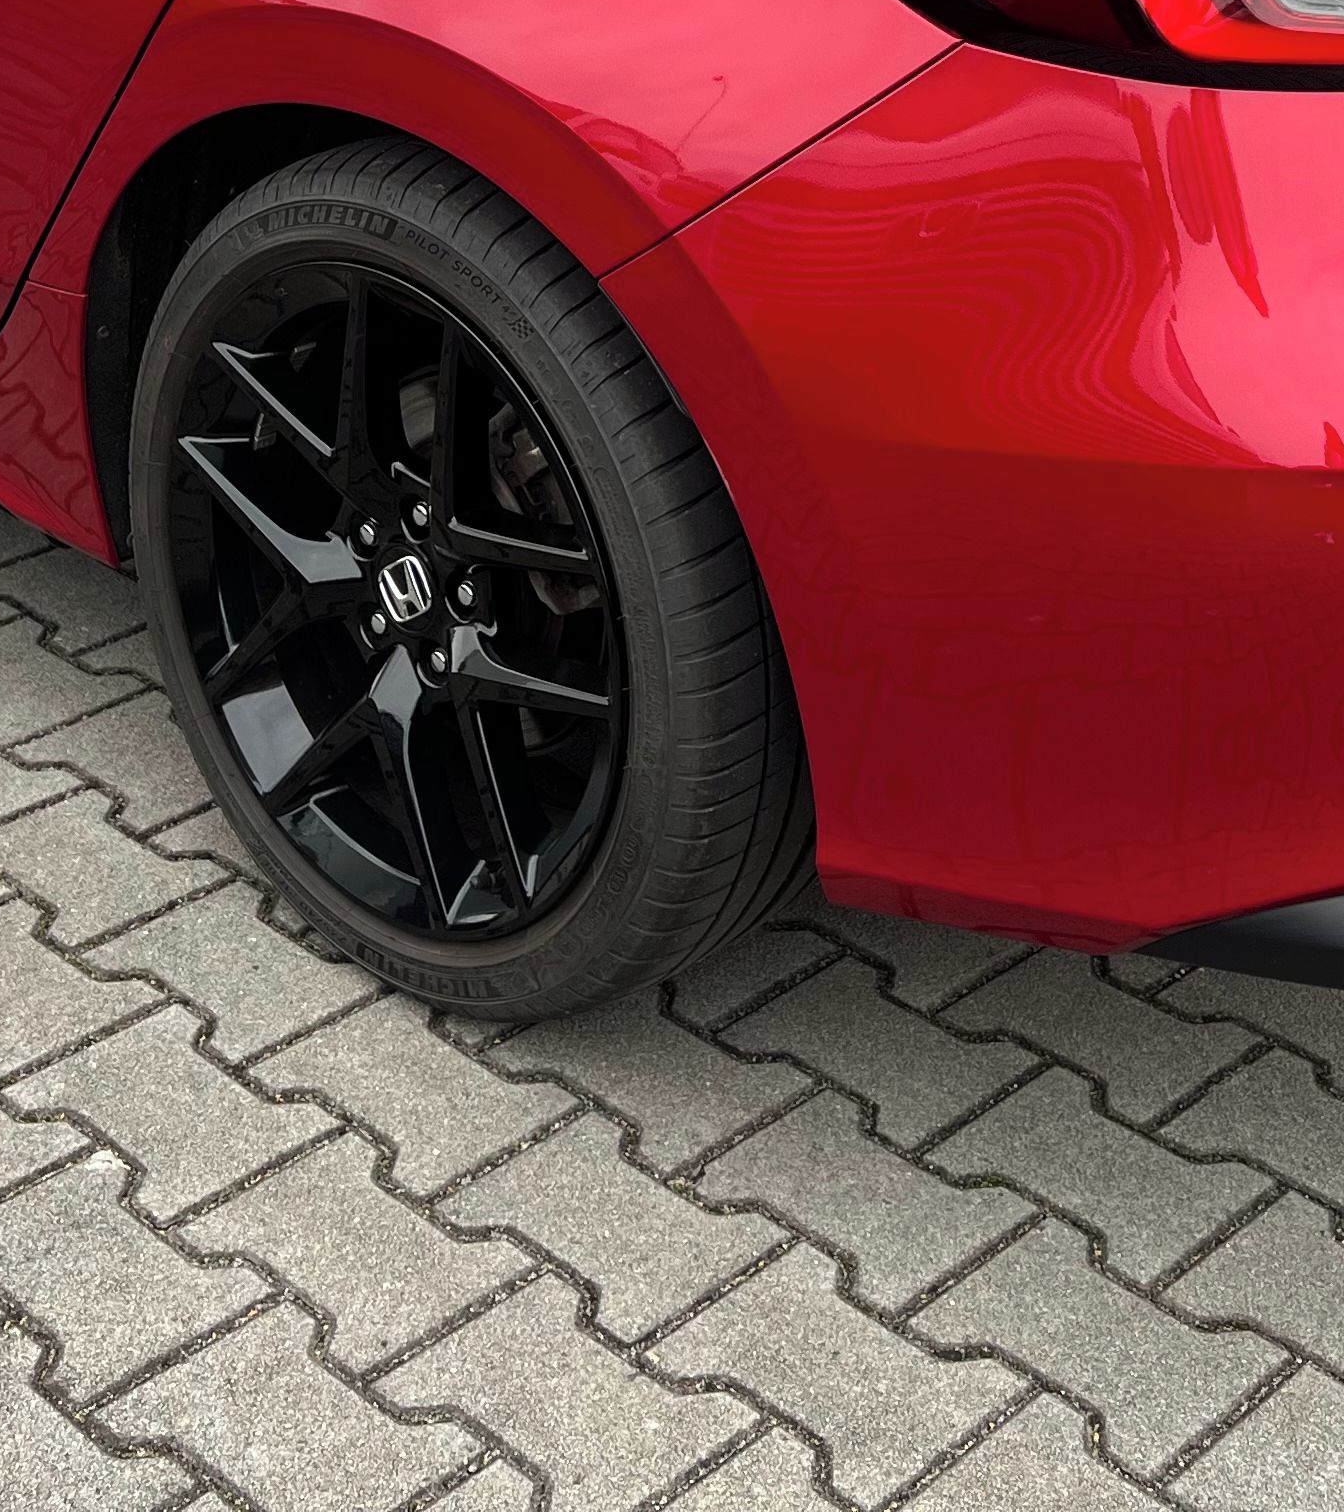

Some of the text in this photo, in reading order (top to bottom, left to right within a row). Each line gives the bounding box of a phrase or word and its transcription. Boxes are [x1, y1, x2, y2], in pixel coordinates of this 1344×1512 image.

[266, 204, 391, 235] MICHELIN
[405, 229, 450, 261] PILOT
[452, 260, 503, 304] SPORT
